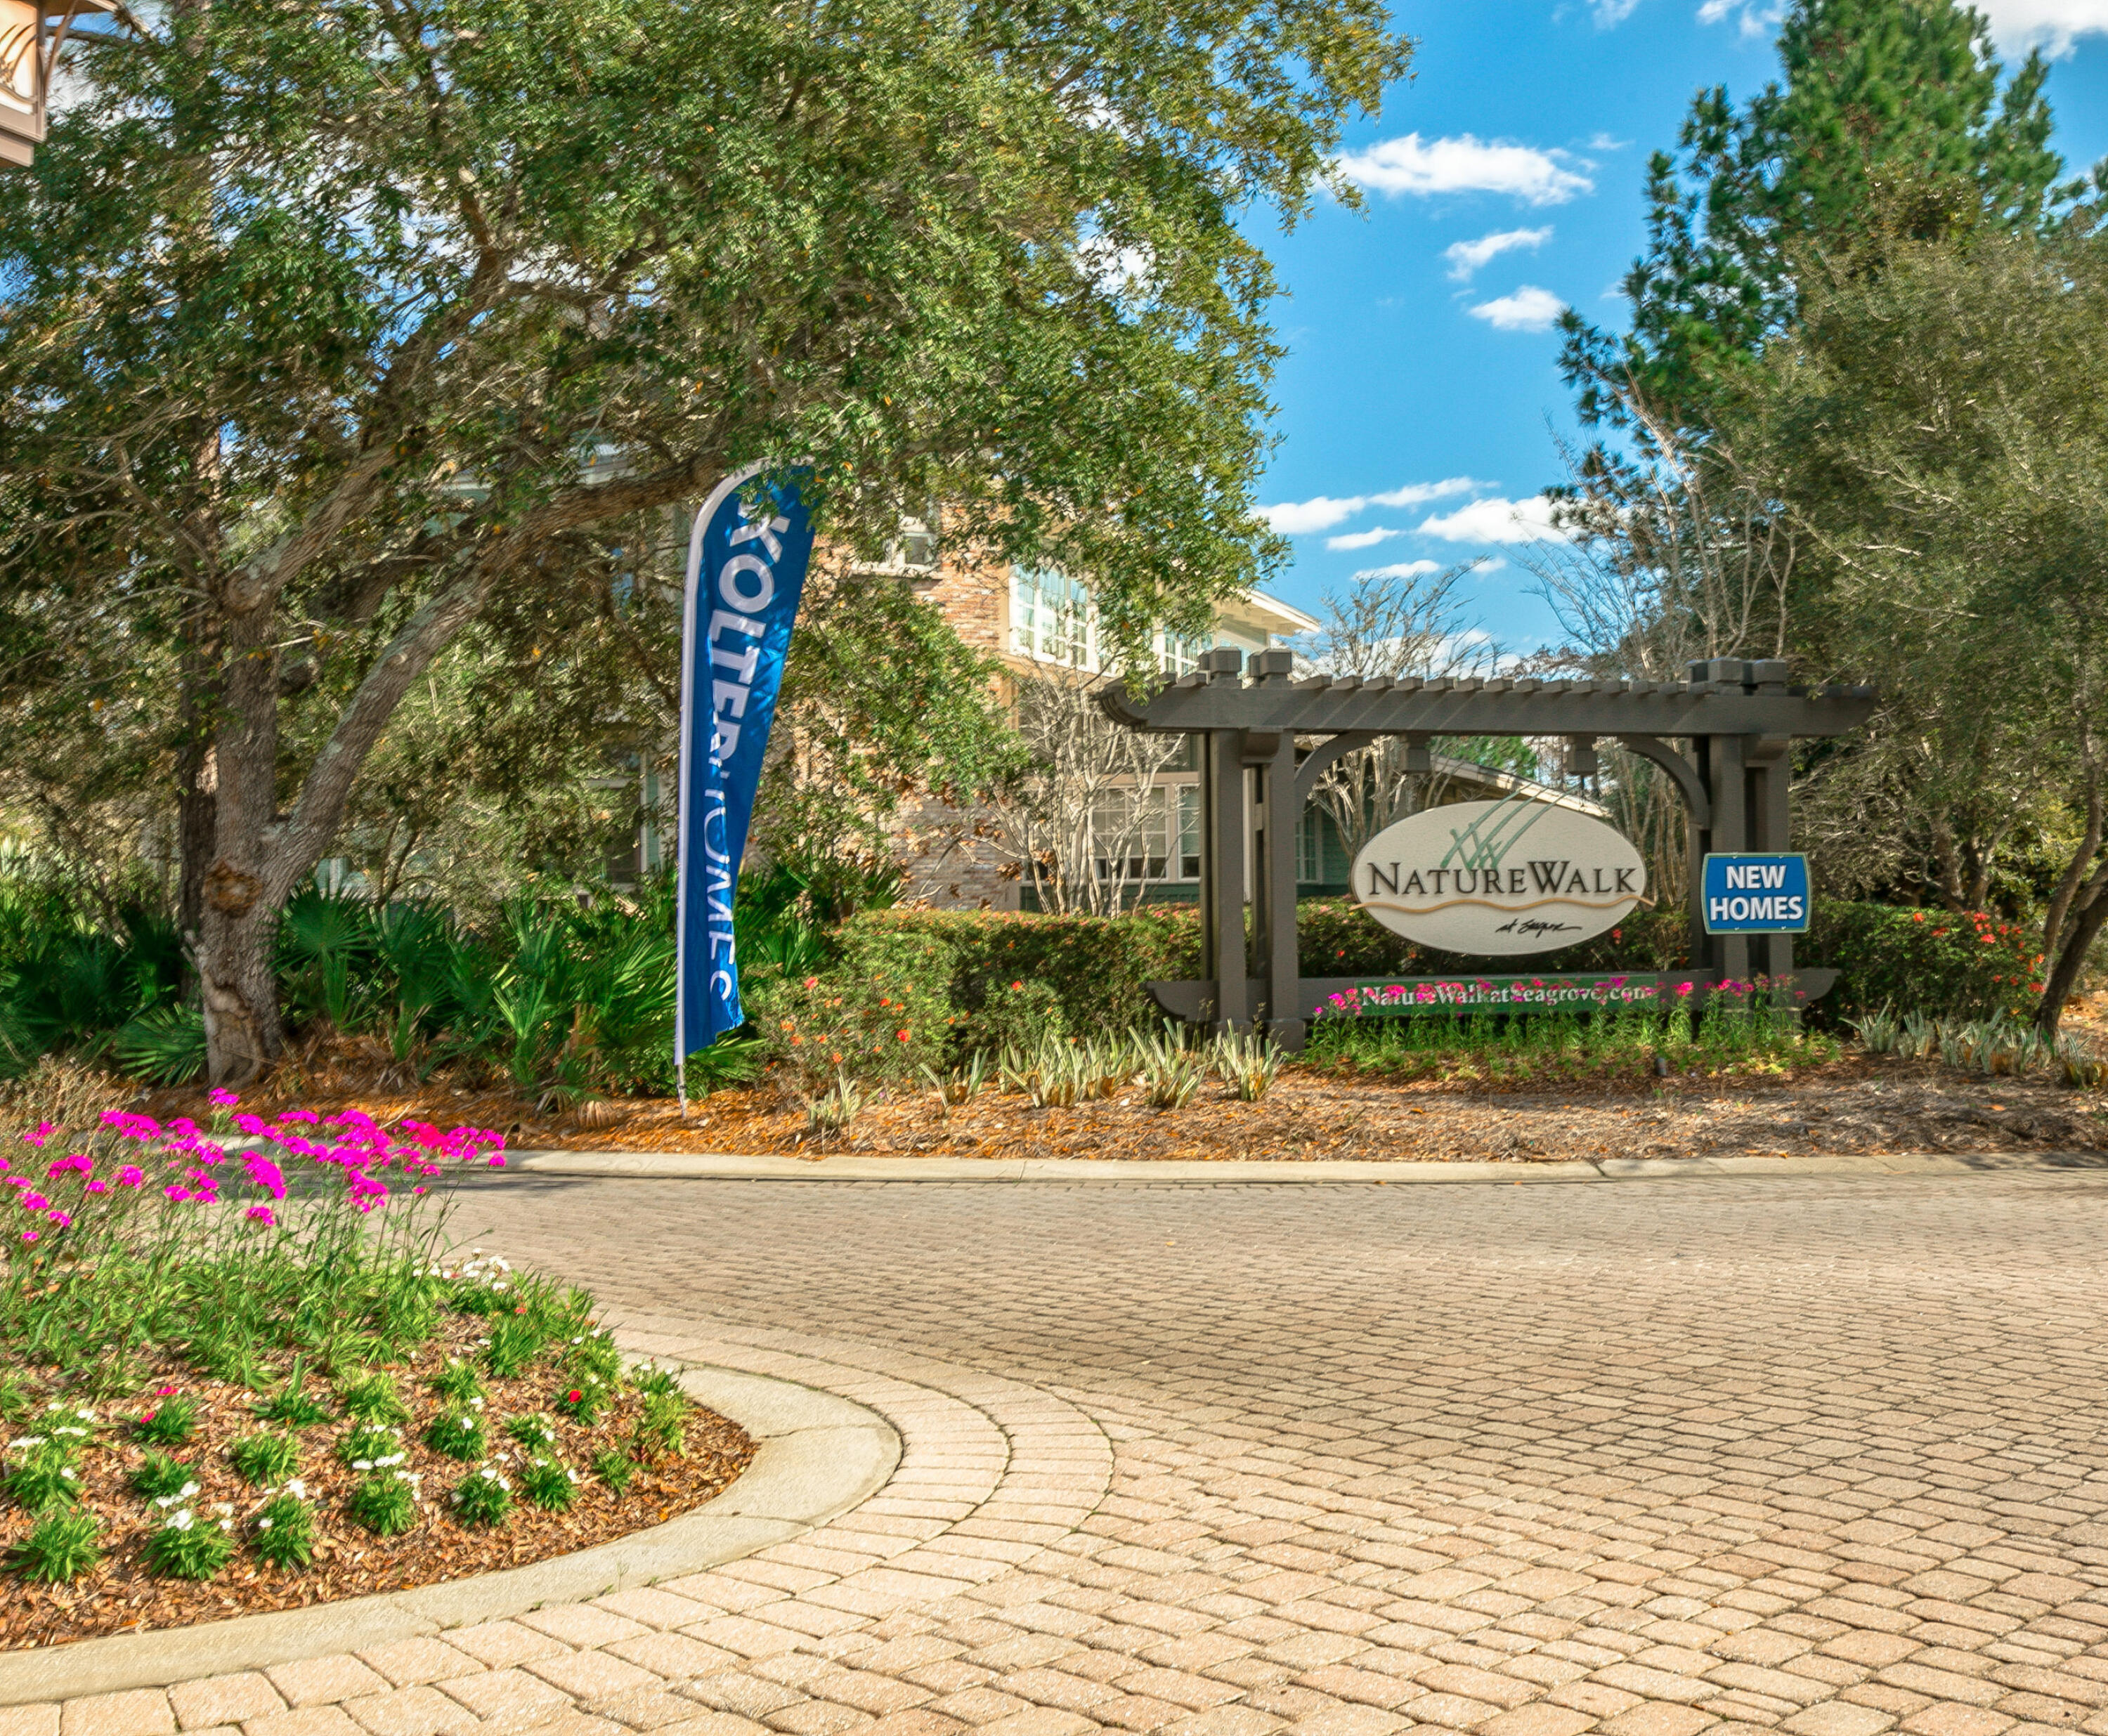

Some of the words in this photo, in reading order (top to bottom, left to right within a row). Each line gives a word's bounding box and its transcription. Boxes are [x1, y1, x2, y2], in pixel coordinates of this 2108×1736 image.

[1367, 861, 1637, 896] NATUREWALK
[1726, 865, 1787, 889] NEW
[1710, 896, 1804, 922] HOMES
